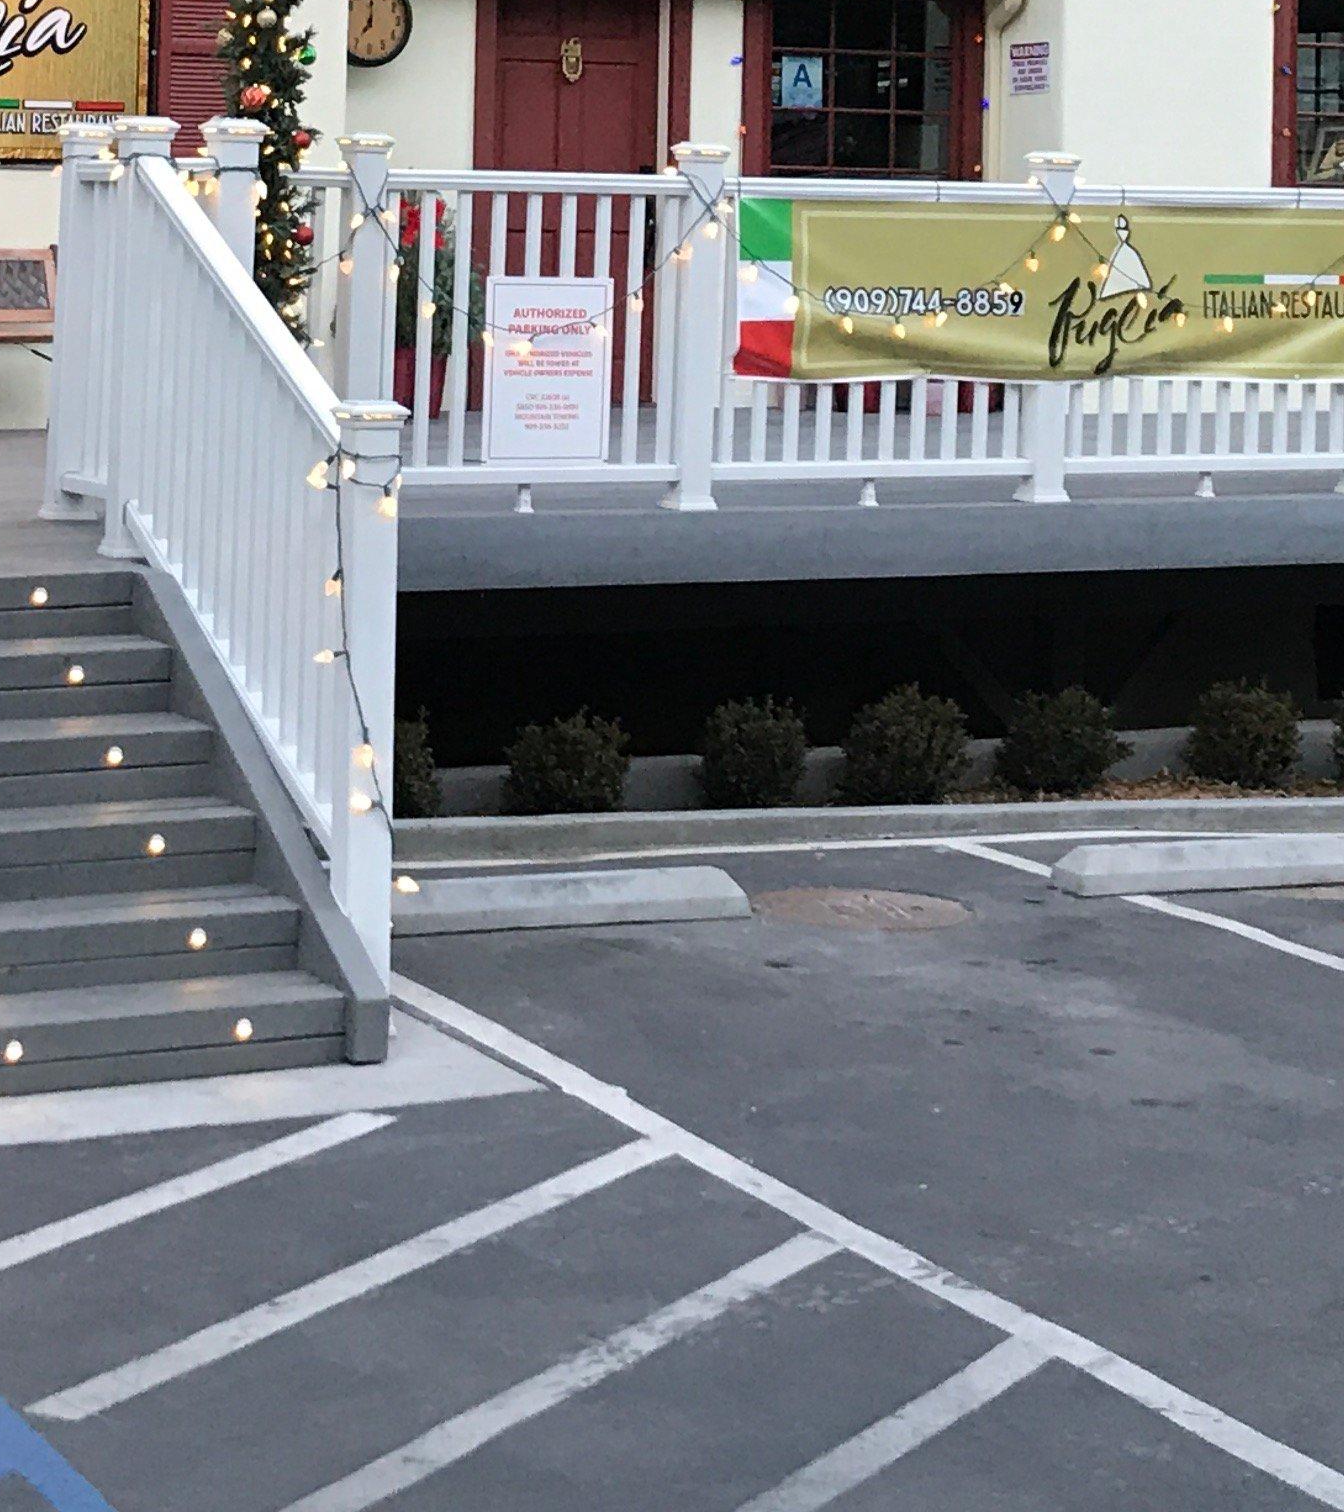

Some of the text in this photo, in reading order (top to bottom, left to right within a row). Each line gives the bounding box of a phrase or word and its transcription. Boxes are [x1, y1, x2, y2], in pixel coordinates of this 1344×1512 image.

[792, 63, 812, 88] A
[513, 308, 587, 319] AUTHORIZED
[824, 286, 1024, 316] (909)744-8859
[1203, 290, 1271, 319] ITALIAN
[508, 323, 590, 336] PARKING ONLY
